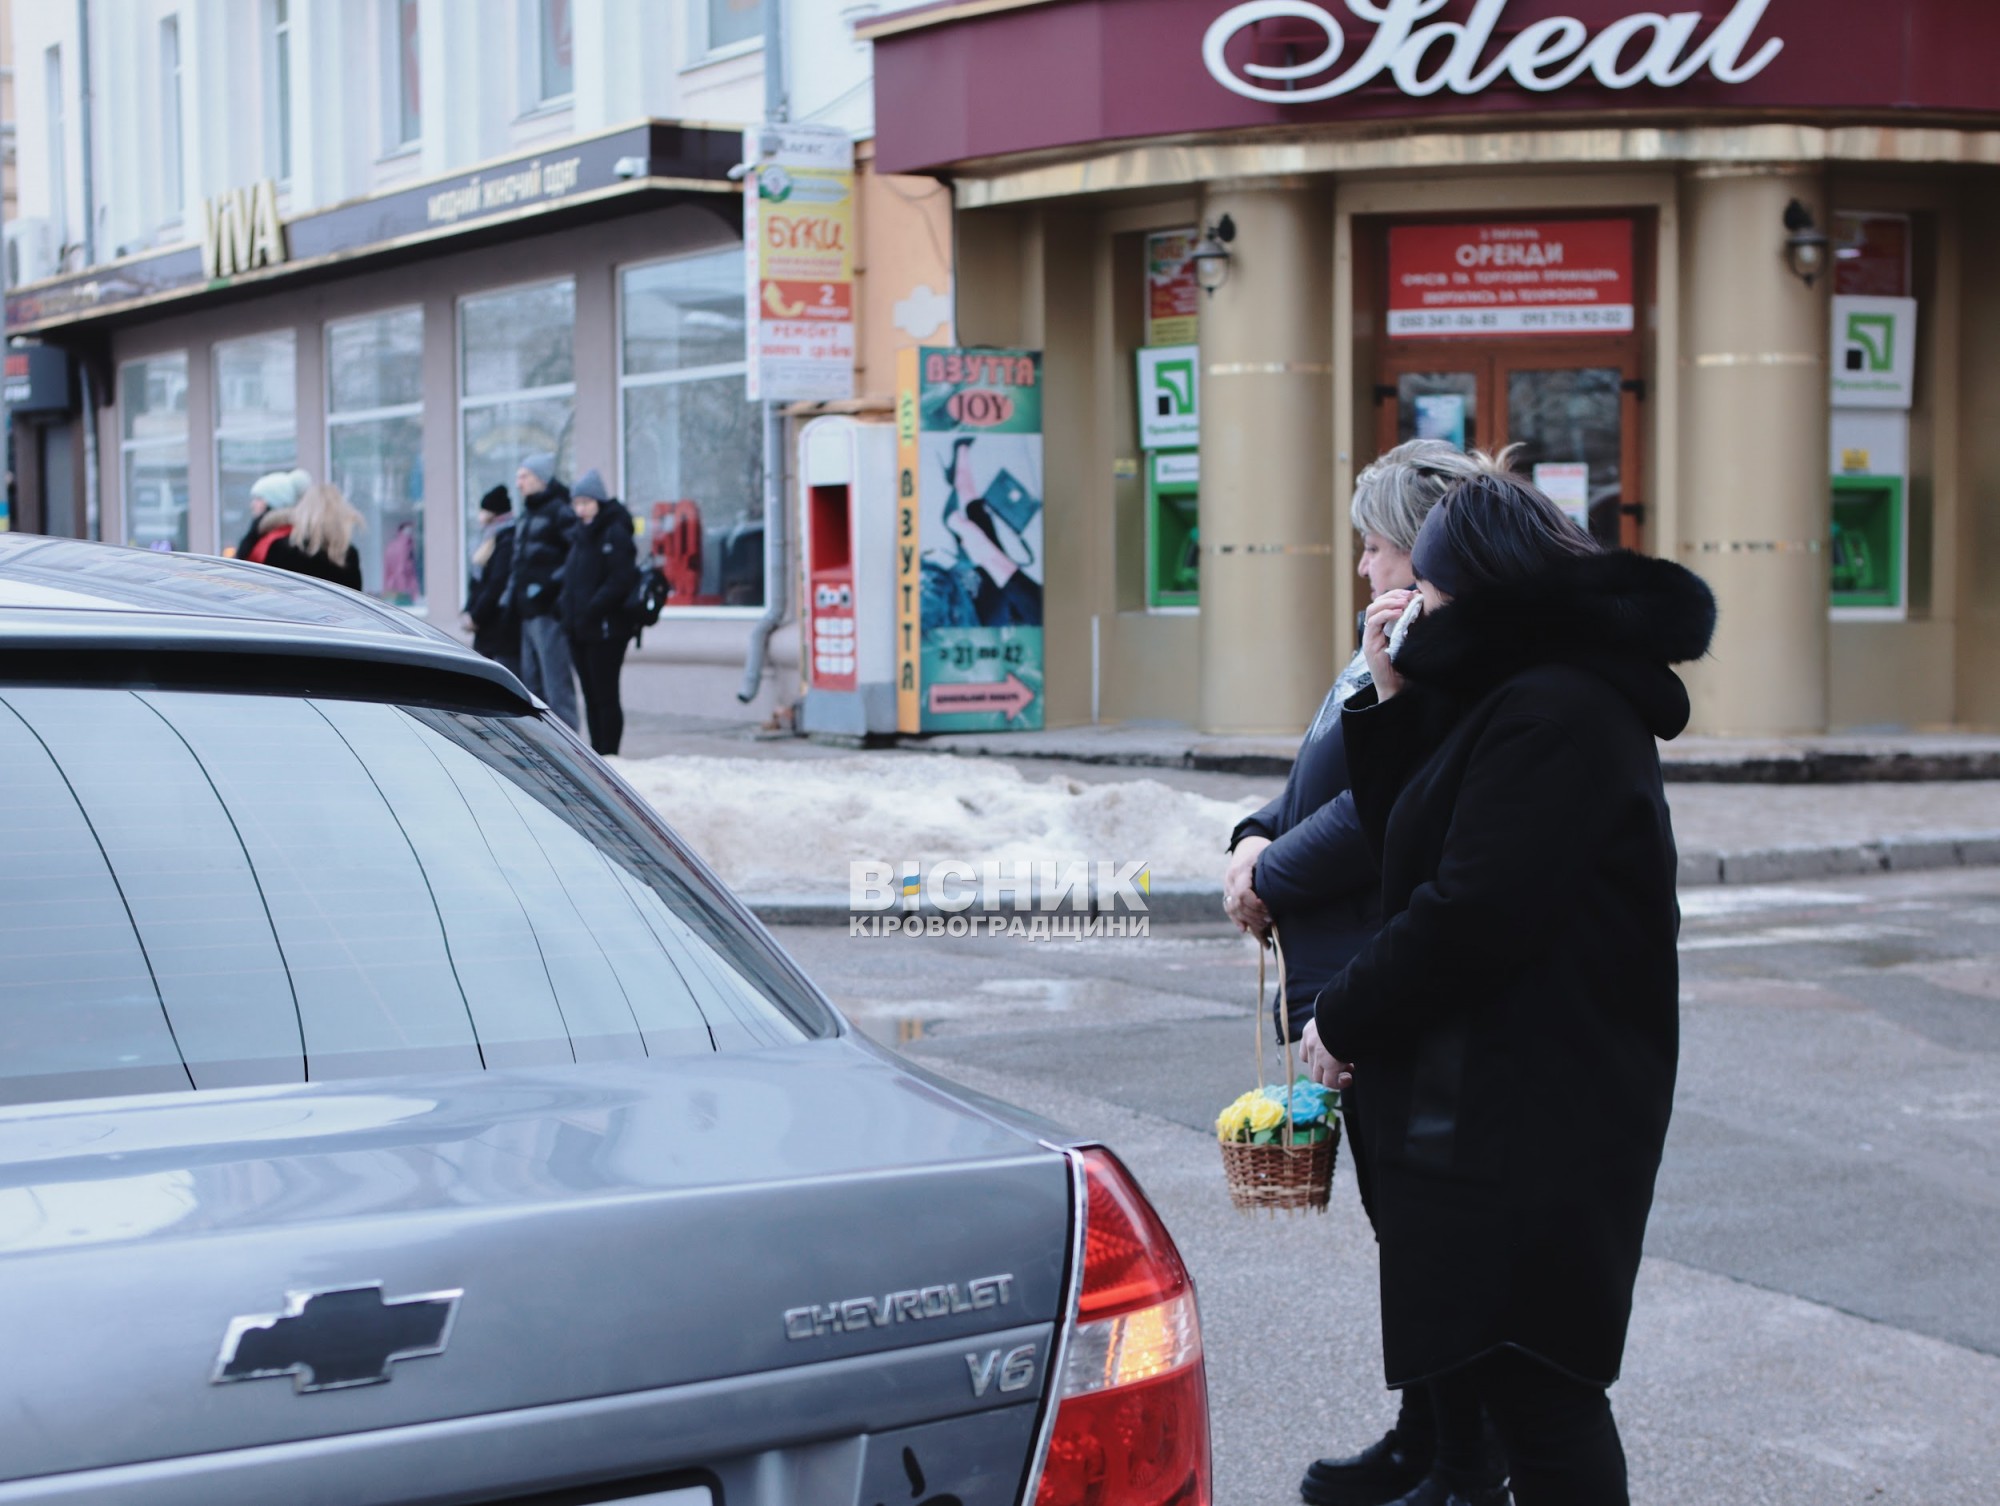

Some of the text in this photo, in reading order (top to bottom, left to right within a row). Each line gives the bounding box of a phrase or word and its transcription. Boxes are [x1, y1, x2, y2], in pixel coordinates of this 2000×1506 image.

[1201, 0, 1786, 103] Ideal
[767, 214, 845, 251] БУКИ
[1455, 243, 1564, 266] ОРЕНДИ
[819, 284, 836, 305] 2
[955, 393, 1009, 422] JOY
[784, 1273, 1013, 1340] CHEVROLET
[965, 1343, 1036, 1397] V6
